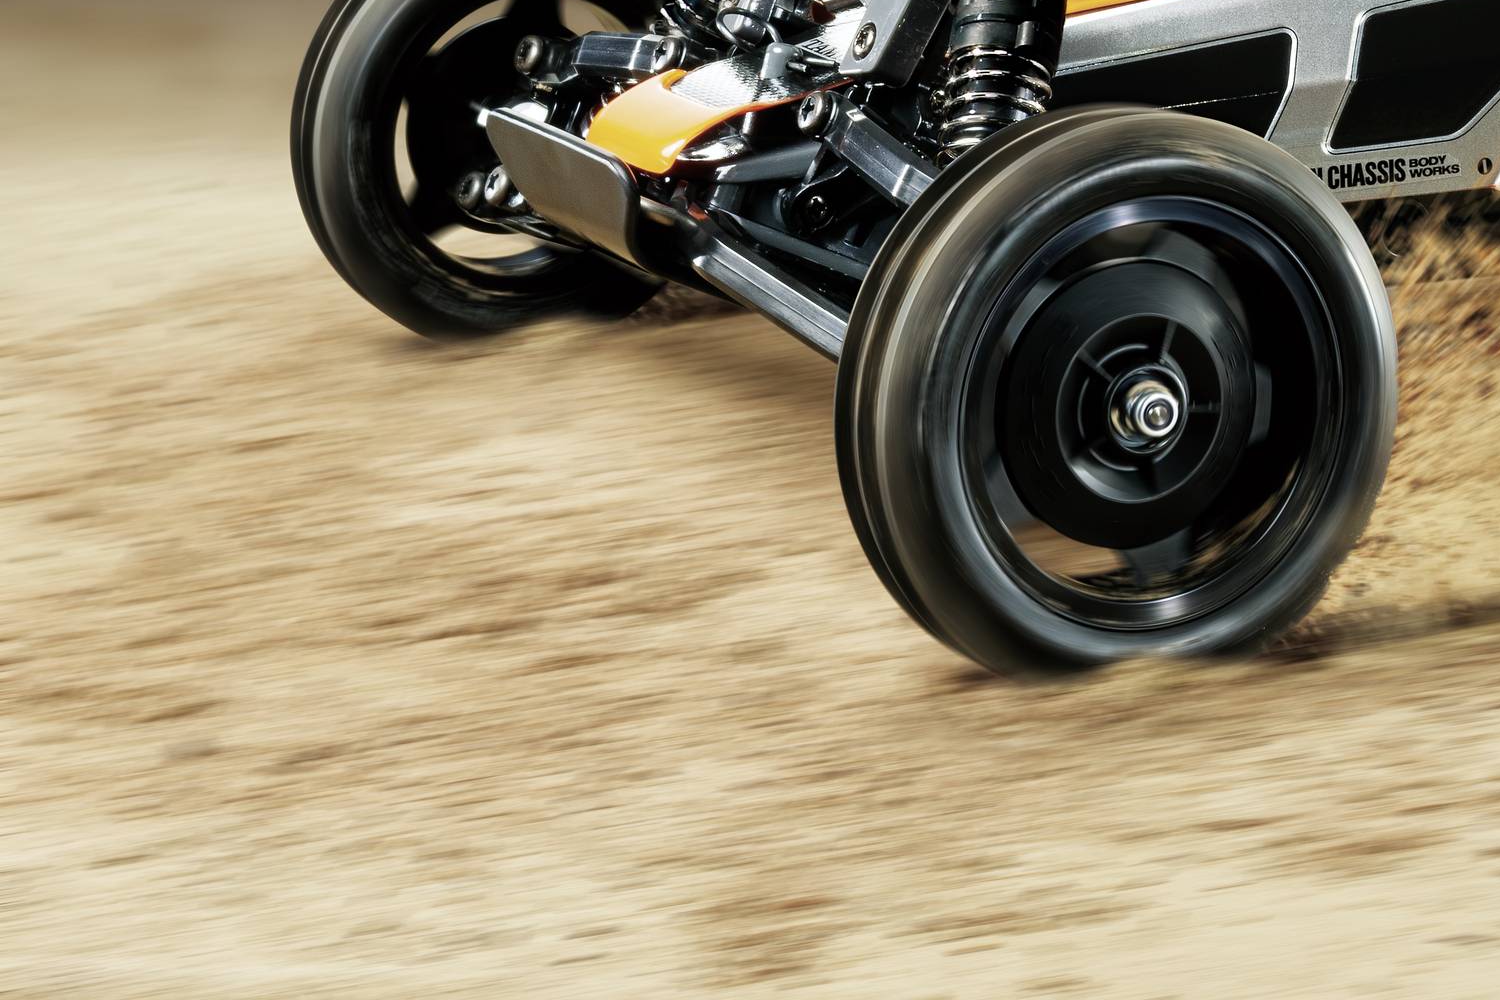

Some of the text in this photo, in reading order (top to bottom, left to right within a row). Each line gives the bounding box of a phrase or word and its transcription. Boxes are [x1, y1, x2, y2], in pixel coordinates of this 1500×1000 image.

[1408, 154, 1447, 168] BODY
[1327, 157, 1407, 190] CHASSIS
[1409, 163, 1460, 179] WORKS
